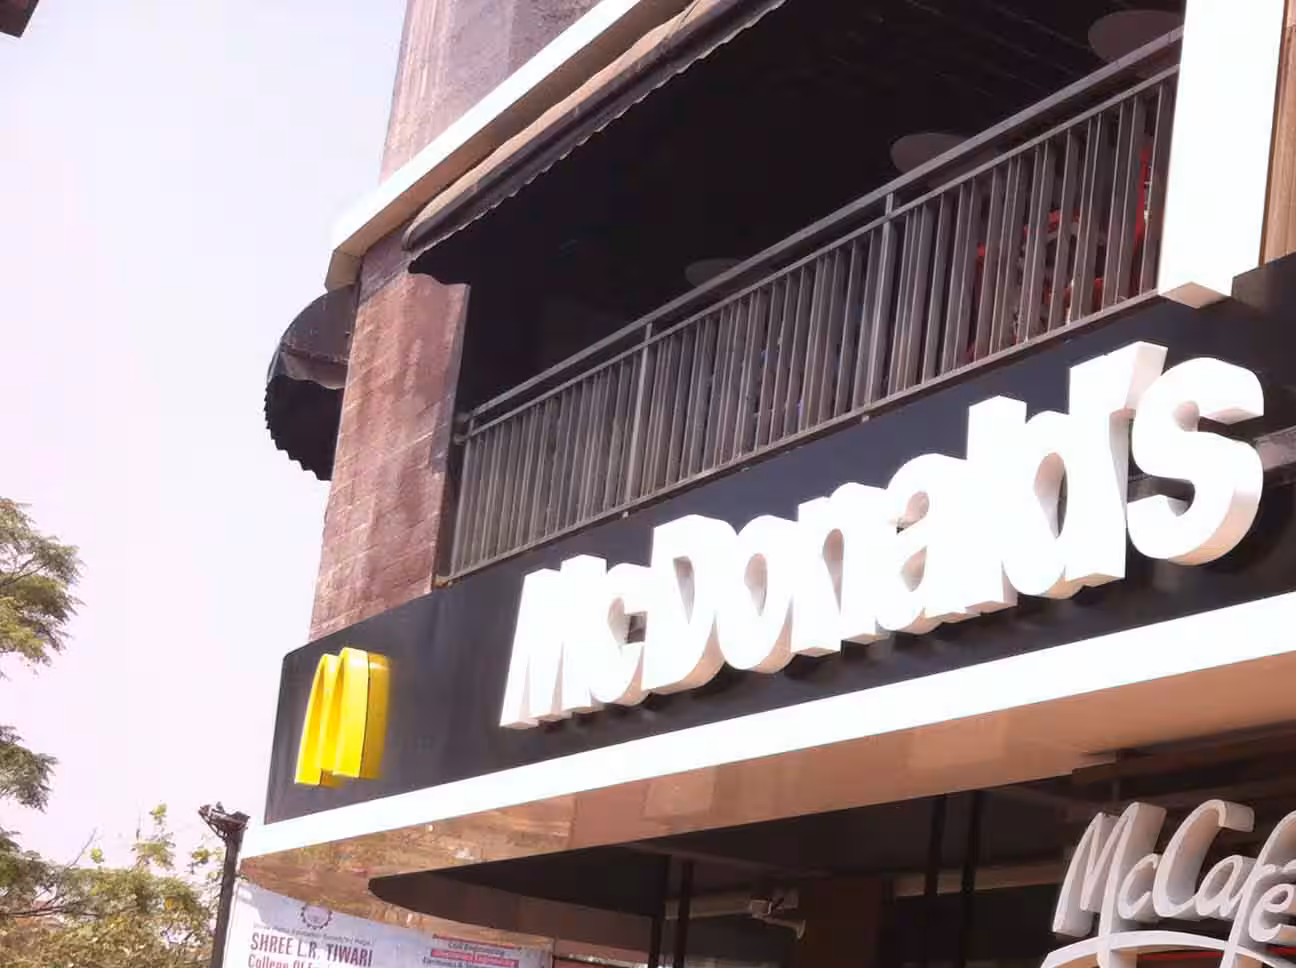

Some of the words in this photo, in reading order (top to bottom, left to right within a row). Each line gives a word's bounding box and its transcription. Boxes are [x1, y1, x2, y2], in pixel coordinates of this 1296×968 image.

[499, 341, 1265, 728] McDonald's
[251, 932, 295, 956] SHREE
[326, 943, 373, 968] TIWARI
